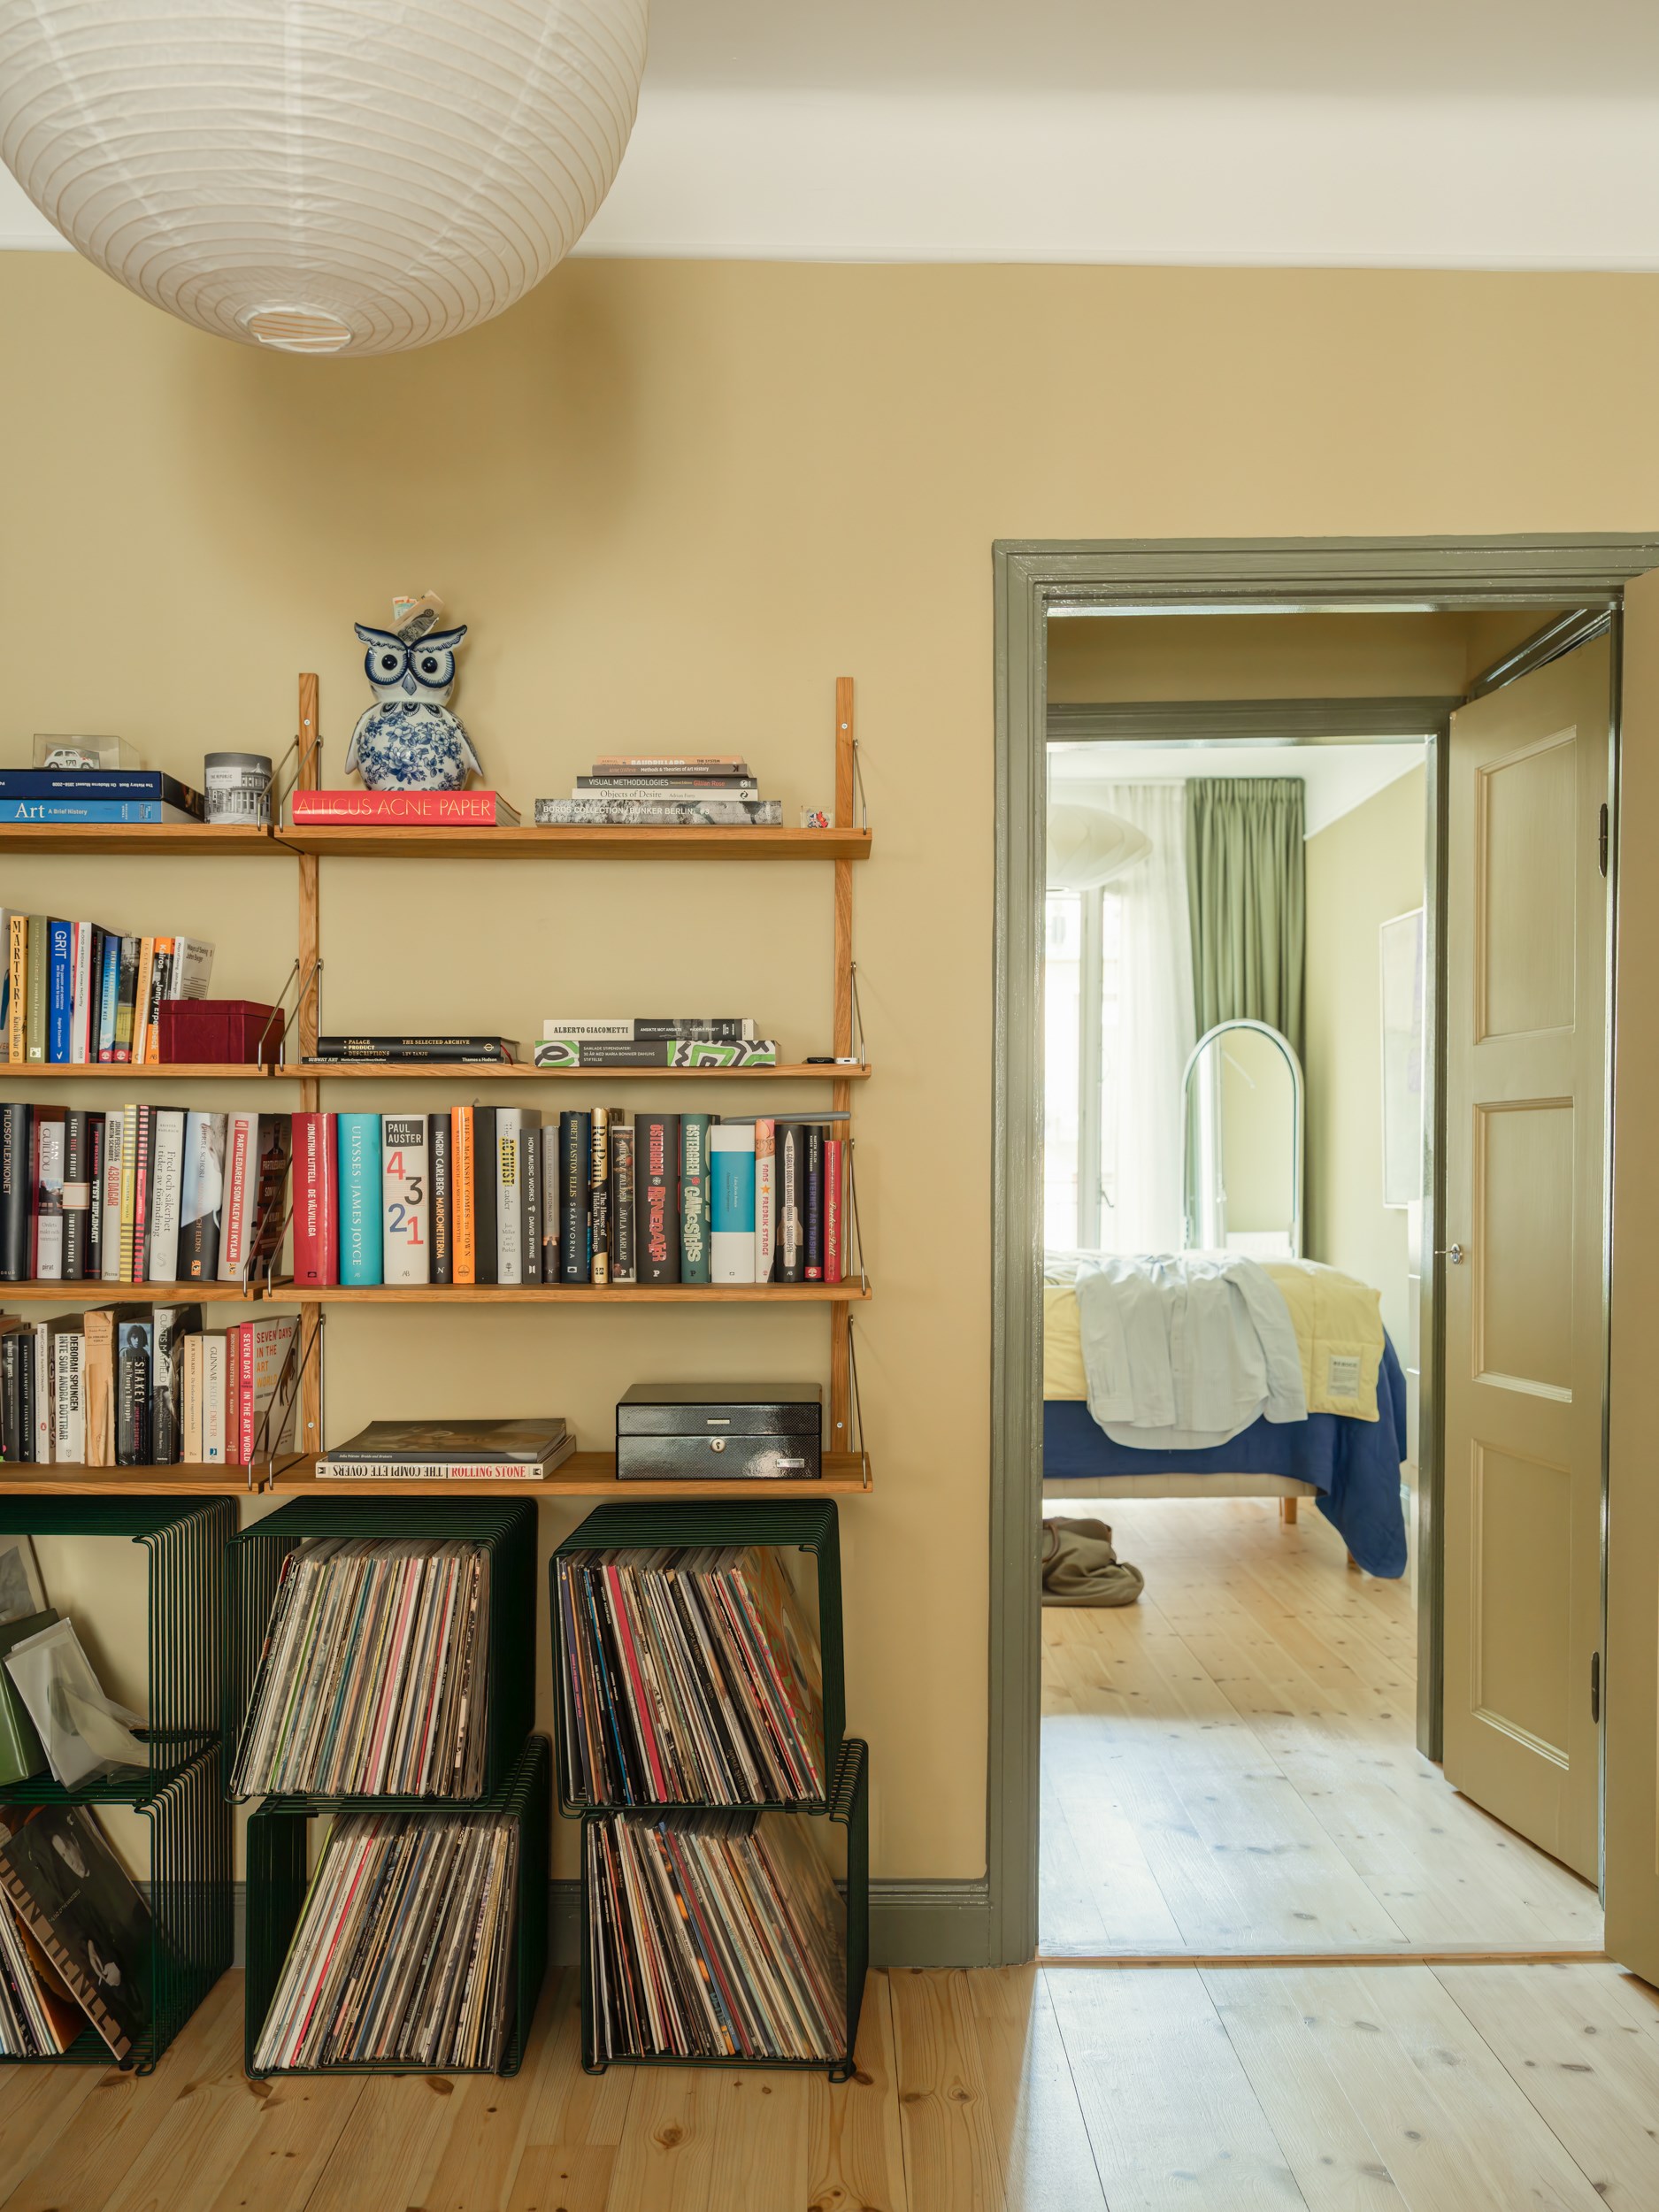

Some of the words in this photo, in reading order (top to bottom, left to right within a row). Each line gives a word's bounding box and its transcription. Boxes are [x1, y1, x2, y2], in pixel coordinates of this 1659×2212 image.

[15, 803, 45, 818] Art
[297, 798, 372, 816] ATTICUS
[377, 799, 432, 816] ACNE
[440, 799, 490, 816] PAPER
[55, 931, 66, 959] GRIT
[157, 944, 166, 969] Kairos
[153, 982, 163, 1004] Jenny
[150, 1008, 159, 1049] Erpenbeck
[307, 1124, 316, 1156] JONATHAN
[388, 1124, 410, 1133] PAUL
[352, 1126, 361, 1176] ULYSSES
[435, 1132, 444, 1156] INGRID
[592, 1125, 606, 1183] RuPaul
[649, 1125, 664, 1175] ÖSTERGREN
[687, 1125, 700, 1175] ÖSTERGREN
[166, 1151, 176, 1171] Fred
[234, 1134, 245, 1185] PARTILEDAREN
[387, 1151, 405, 1179] 4
[108, 1166, 119, 1181] 438
[165, 1175, 175, 1190] och
[435, 1158, 444, 1194] CARLBERG
[108, 1183, 118, 1206] DAGAR
[233, 1187, 242, 1202] SOM
[404, 1177, 423, 1205] 3
[164, 1194, 175, 1232] säkerhet
[308, 1199, 318, 1236] VÄLVILLIGA
[349, 1185, 361, 1224] JAMES
[388, 1203, 407, 1233] 2
[407, 1217, 424, 1245] 1
[648, 1187, 666, 1261] RENEGATER
[684, 1187, 703, 1262] GANGSTERS
[810, 1214, 818, 1223] ÄR
[230, 1234, 239, 1257] KYLAN
[350, 1228, 361, 1265] JOYCE
[257, 1330, 276, 1343] SEVEN
[279, 1327, 292, 1340] DAYS
[257, 1347, 264, 1357] IN
[266, 1344, 276, 1356] THE
[257, 1361, 268, 1372] ART
[59, 1376, 68, 1402] ANDRA
[134, 1362, 144, 1403] SHAKEY
[257, 1374, 277, 1387] WORLD
[59, 1404, 69, 1440] DÖTTRAR
[334, 1465, 367, 1477] COVERS
[371, 1466, 420, 1477] COMPLETE
[424, 1466, 442, 1477] THE
[451, 1466, 492, 1477] ROLLING
[495, 1466, 526, 1478] STONE
